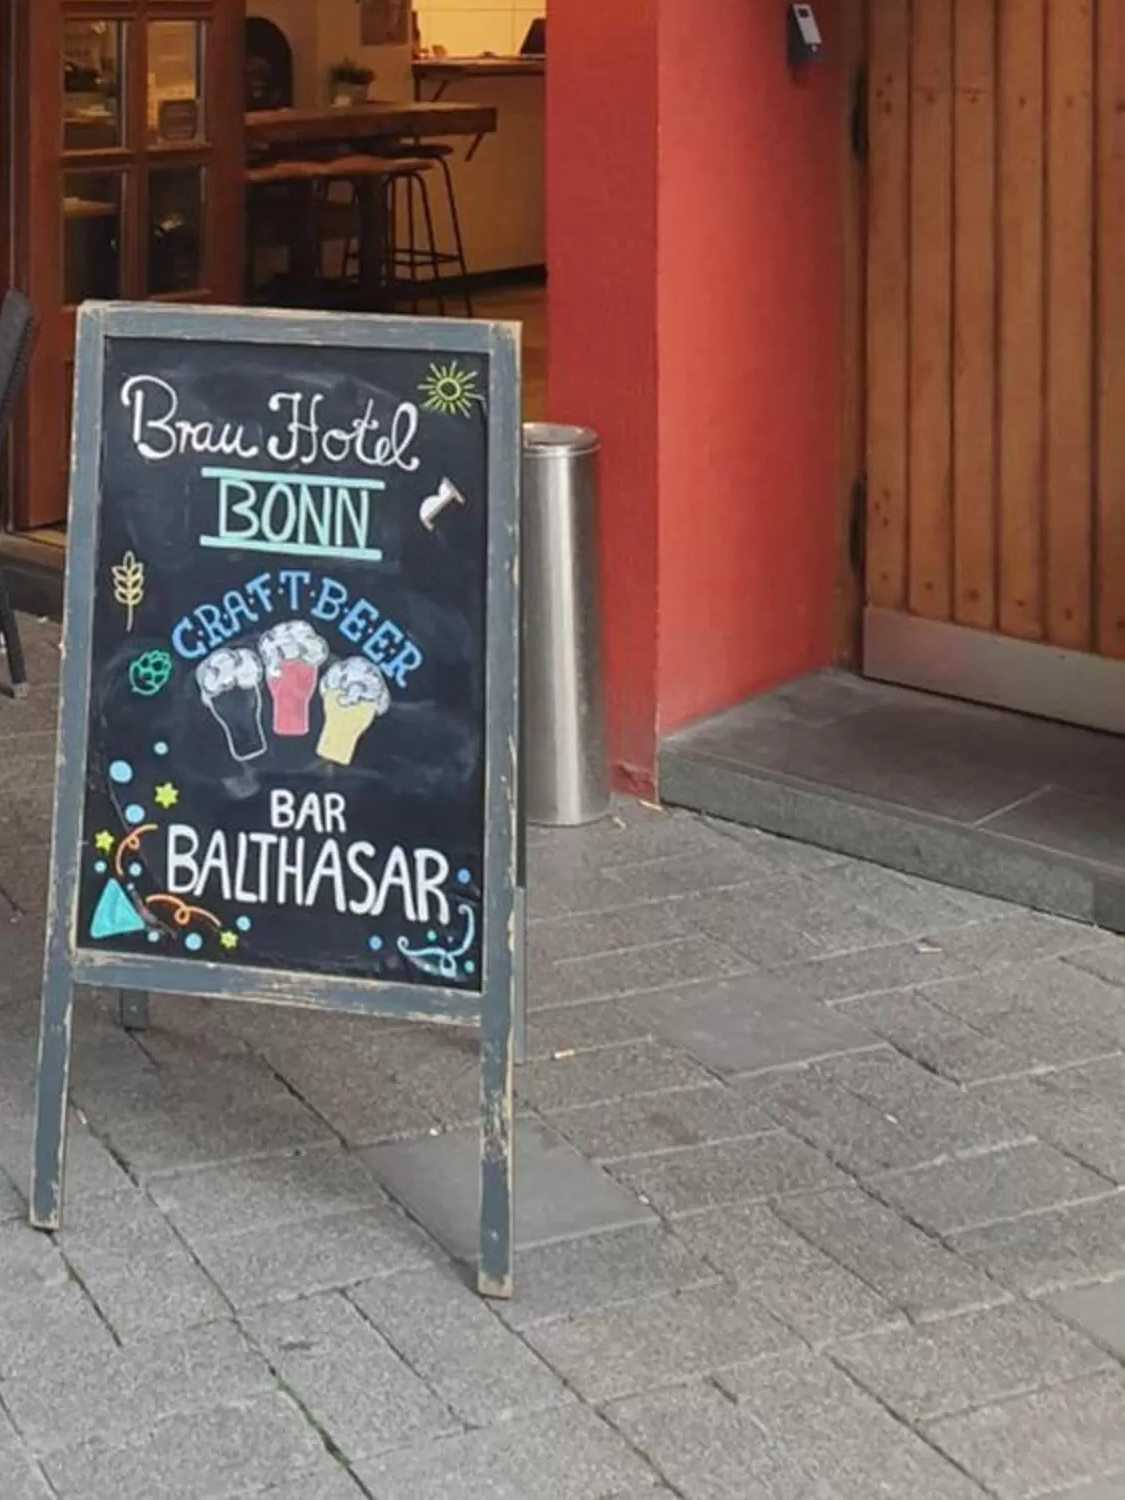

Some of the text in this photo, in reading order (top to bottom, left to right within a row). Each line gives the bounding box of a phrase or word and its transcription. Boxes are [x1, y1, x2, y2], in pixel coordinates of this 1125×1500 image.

[121, 374, 421, 472] Brau Hotel
[218, 478, 370, 549] BONN
[270, 789, 347, 833] BAR
[167, 824, 450, 925] BALTHASAR
